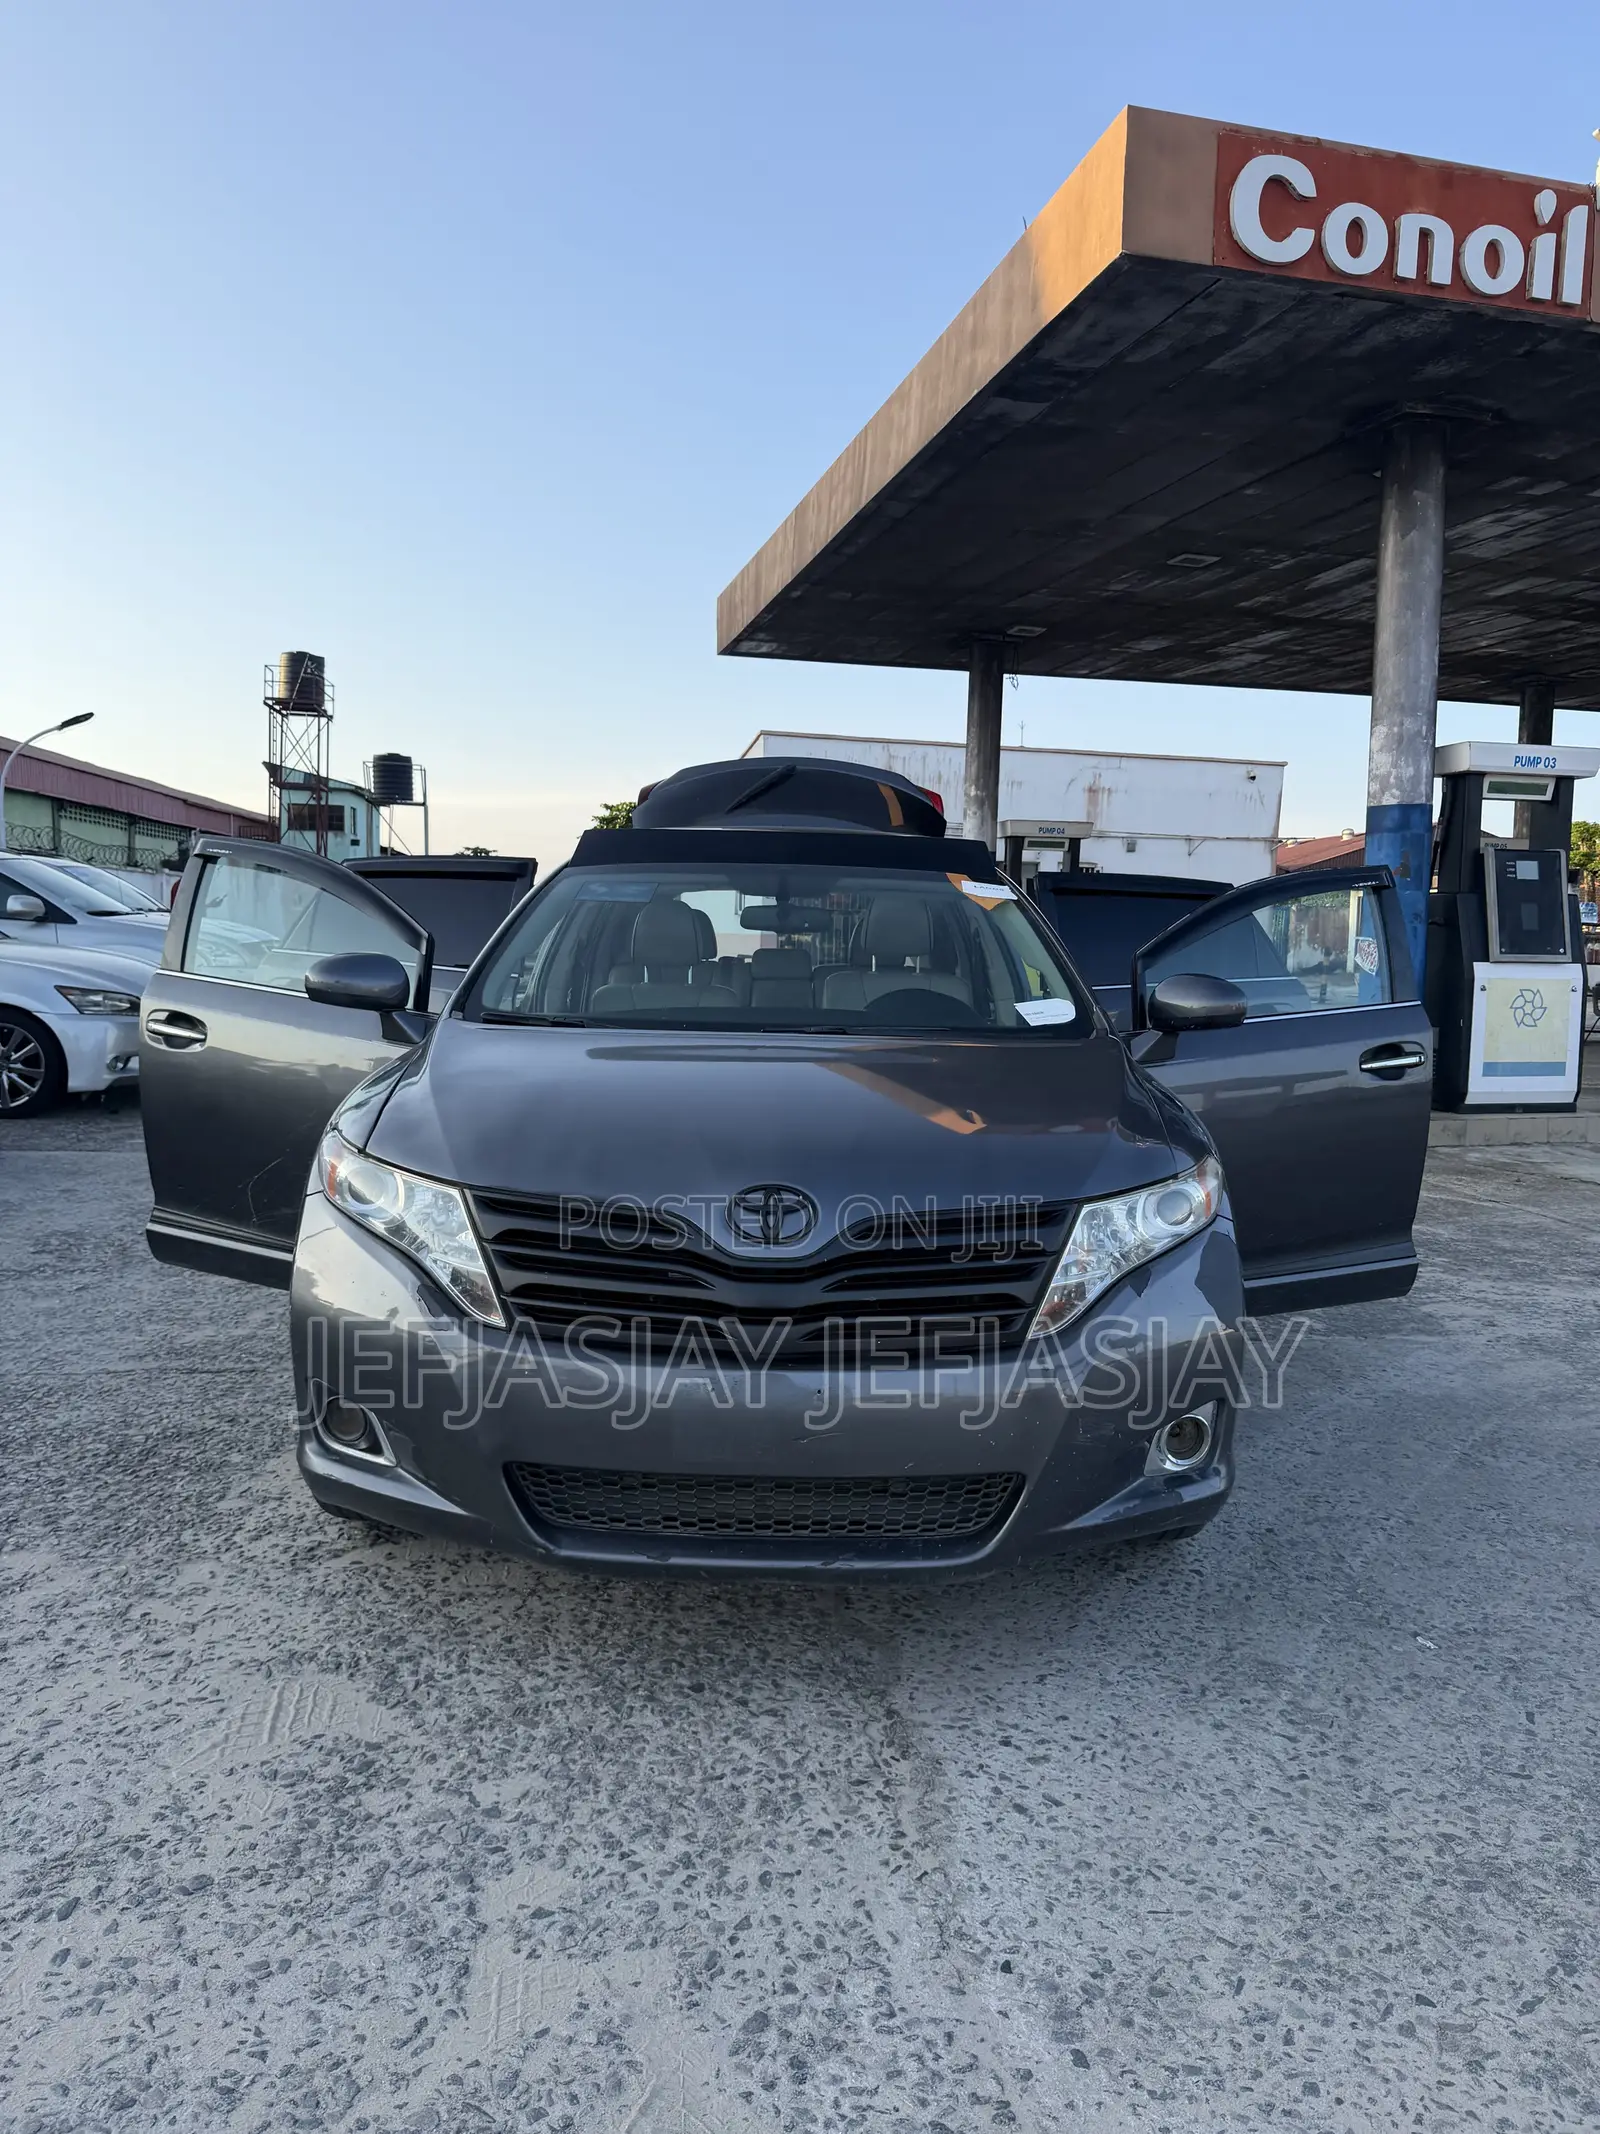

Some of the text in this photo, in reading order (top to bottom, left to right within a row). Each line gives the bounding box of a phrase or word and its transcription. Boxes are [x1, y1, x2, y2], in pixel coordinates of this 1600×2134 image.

[1230, 154, 1589, 306] Conoil
[1513, 755, 1557, 769] PUMP 03
[1038, 827, 1065, 835] PUMP 04
